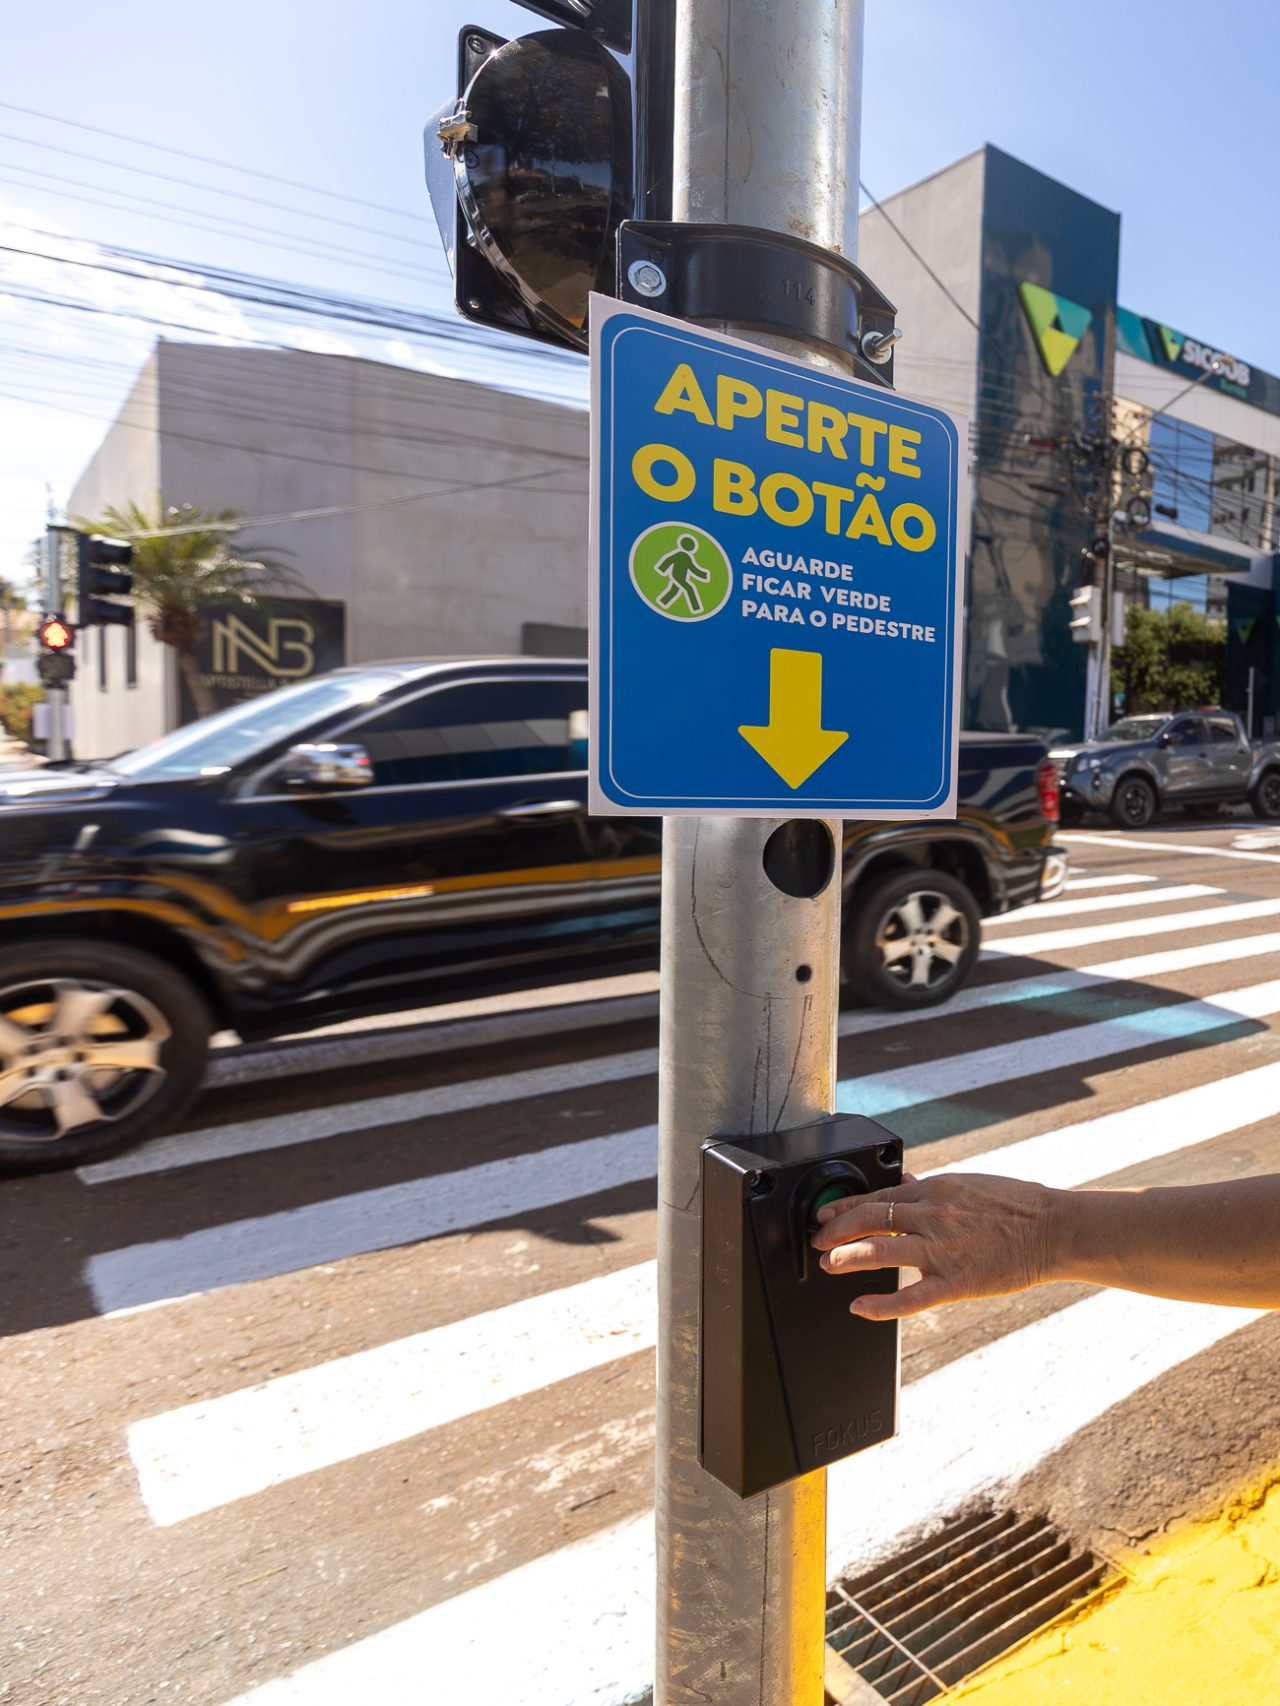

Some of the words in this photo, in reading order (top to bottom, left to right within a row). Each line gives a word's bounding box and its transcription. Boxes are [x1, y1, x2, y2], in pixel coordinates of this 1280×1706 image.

[783, 278, 815, 306] 114
[654, 363, 922, 479] APERTE
[631, 443, 696, 503] O
[712, 458, 937, 552] BOTÃO
[741, 547, 853, 582] AGUARDE
[742, 573, 811, 600] FICAR
[820, 586, 891, 612] VERDE
[742, 599, 806, 626] PARA
[810, 610, 827, 628] O
[832, 612, 937, 643] PEDESTRE
[812, 1409, 883, 1457] FOKUS
